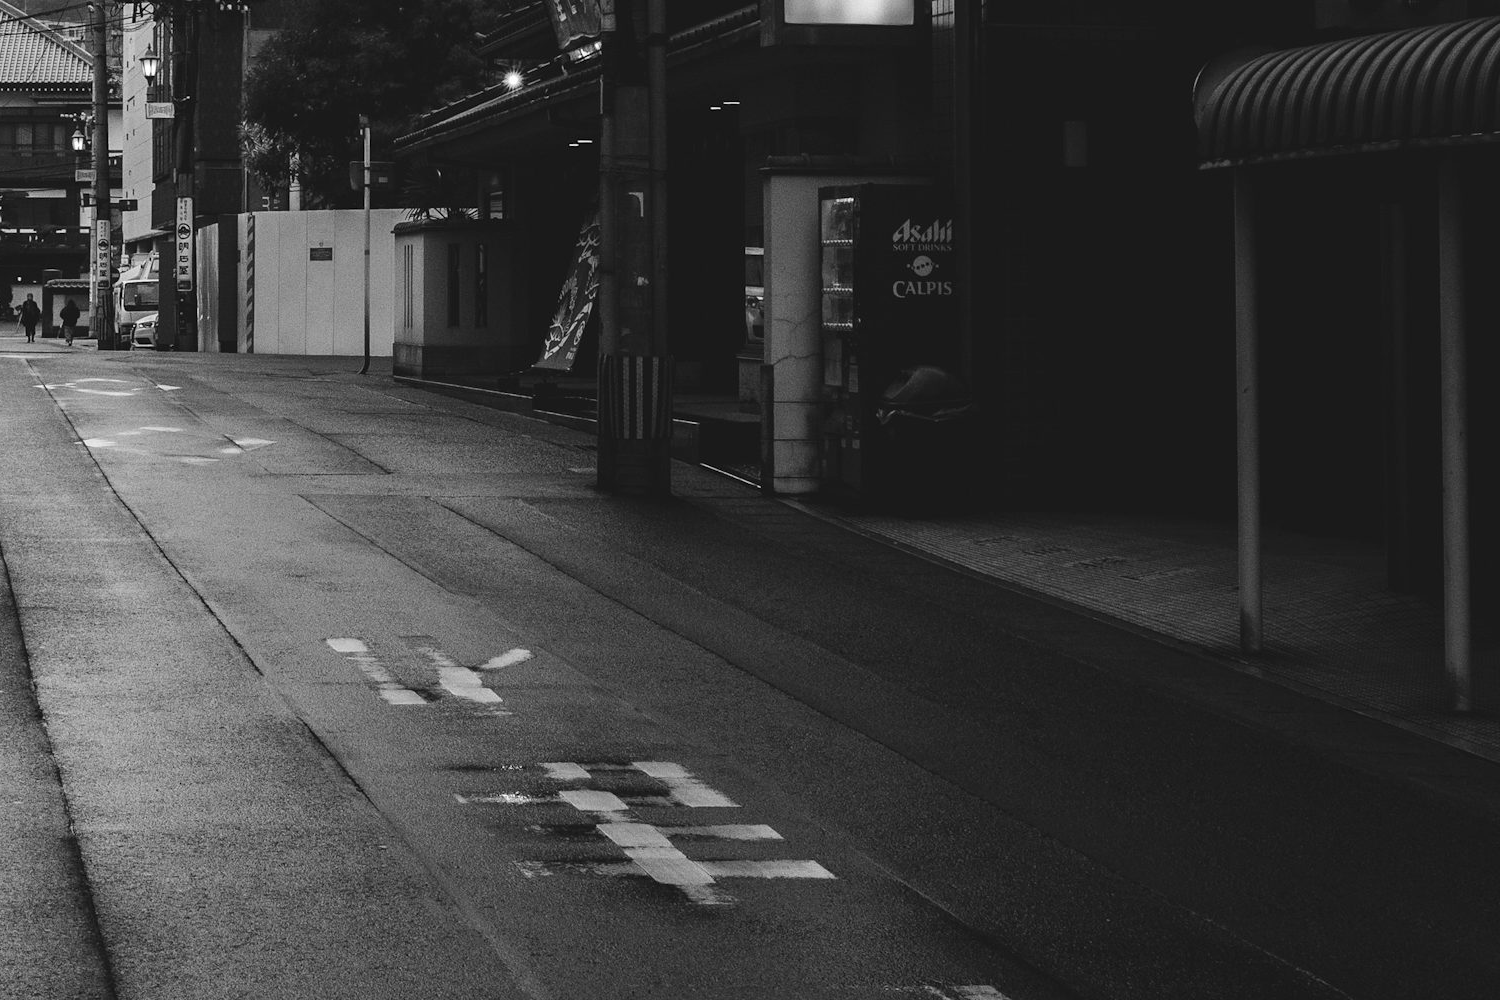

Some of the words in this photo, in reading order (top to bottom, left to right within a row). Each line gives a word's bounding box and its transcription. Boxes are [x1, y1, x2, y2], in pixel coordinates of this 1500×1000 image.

[892, 218, 953, 243] Asahi
[892, 242, 915, 252] SOFT
[918, 242, 953, 252] DRINKS
[892, 280, 953, 299] CALPIS
